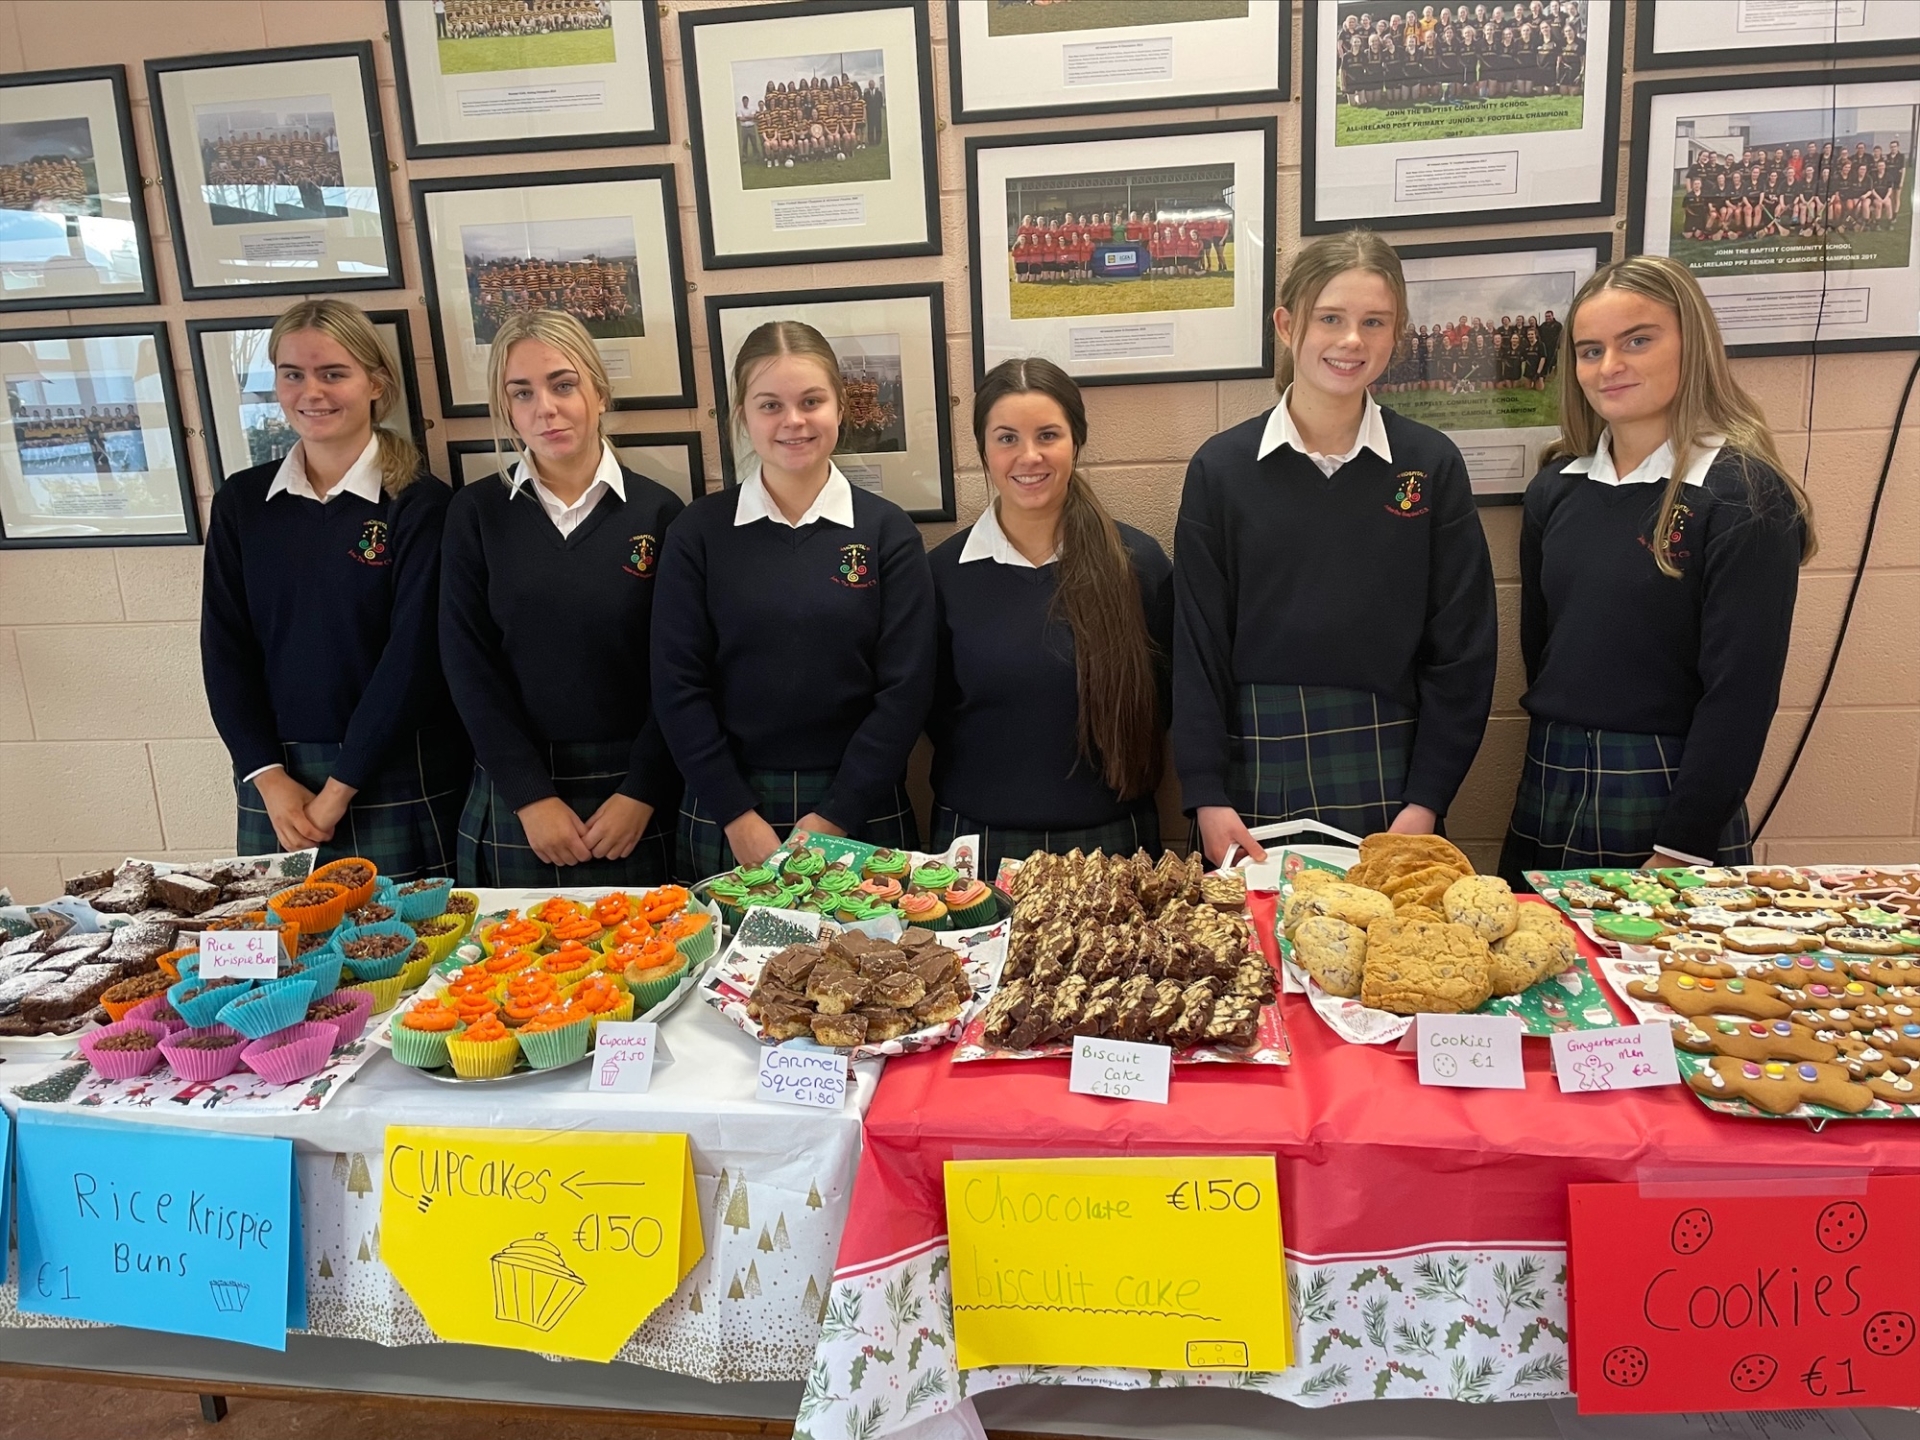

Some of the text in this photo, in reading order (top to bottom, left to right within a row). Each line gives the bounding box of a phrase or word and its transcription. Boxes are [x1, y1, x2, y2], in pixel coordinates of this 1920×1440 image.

[1423, 106, 1452, 114] BAPTIST
[1454, 103, 1497, 111] COMMUNITY
[1346, 123, 1390, 132] ALL-IRELAND
[1392, 121, 1411, 129] POST
[1413, 119, 1445, 127] PRIMARY
[1487, 113, 1524, 121] FOOTBALL
[1526, 110, 1568, 119] CHAMPIONS
[1689, 260, 1733, 268] ALL-IRELAND
[1446, 398, 1487, 406] COMMUNITY
[1492, 396, 1519, 404] SCHOOL
[1421, 411, 1446, 419] JUNIOR
[1496, 407, 1537, 415] CHAMPIONS
[206, 937, 263, 951] Rice €1
[213, 952, 277, 967] Krispie Buns
[599, 1033, 647, 1048] Cupcakes
[1430, 1032, 1492, 1048] Cookies
[1567, 1033, 1641, 1052] Gingerbread
[1082, 1045, 1141, 1064] Biscuit
[1469, 1052, 1494, 1068] €1
[1104, 1067, 1145, 1081] Cake
[1632, 1062, 1657, 1076] €2
[964, 1175, 1261, 1225] Chocolate €1.50
[73, 1172, 273, 1250] Rice Krispie
[572, 1212, 663, 1258] €1.50
[114, 1242, 188, 1277] Buns
[37, 1262, 81, 1300] €1
[972, 1245, 1201, 1311] biscuit cake
[1644, 1265, 1862, 1332] Cookies
[1800, 1355, 1867, 1397] €1
